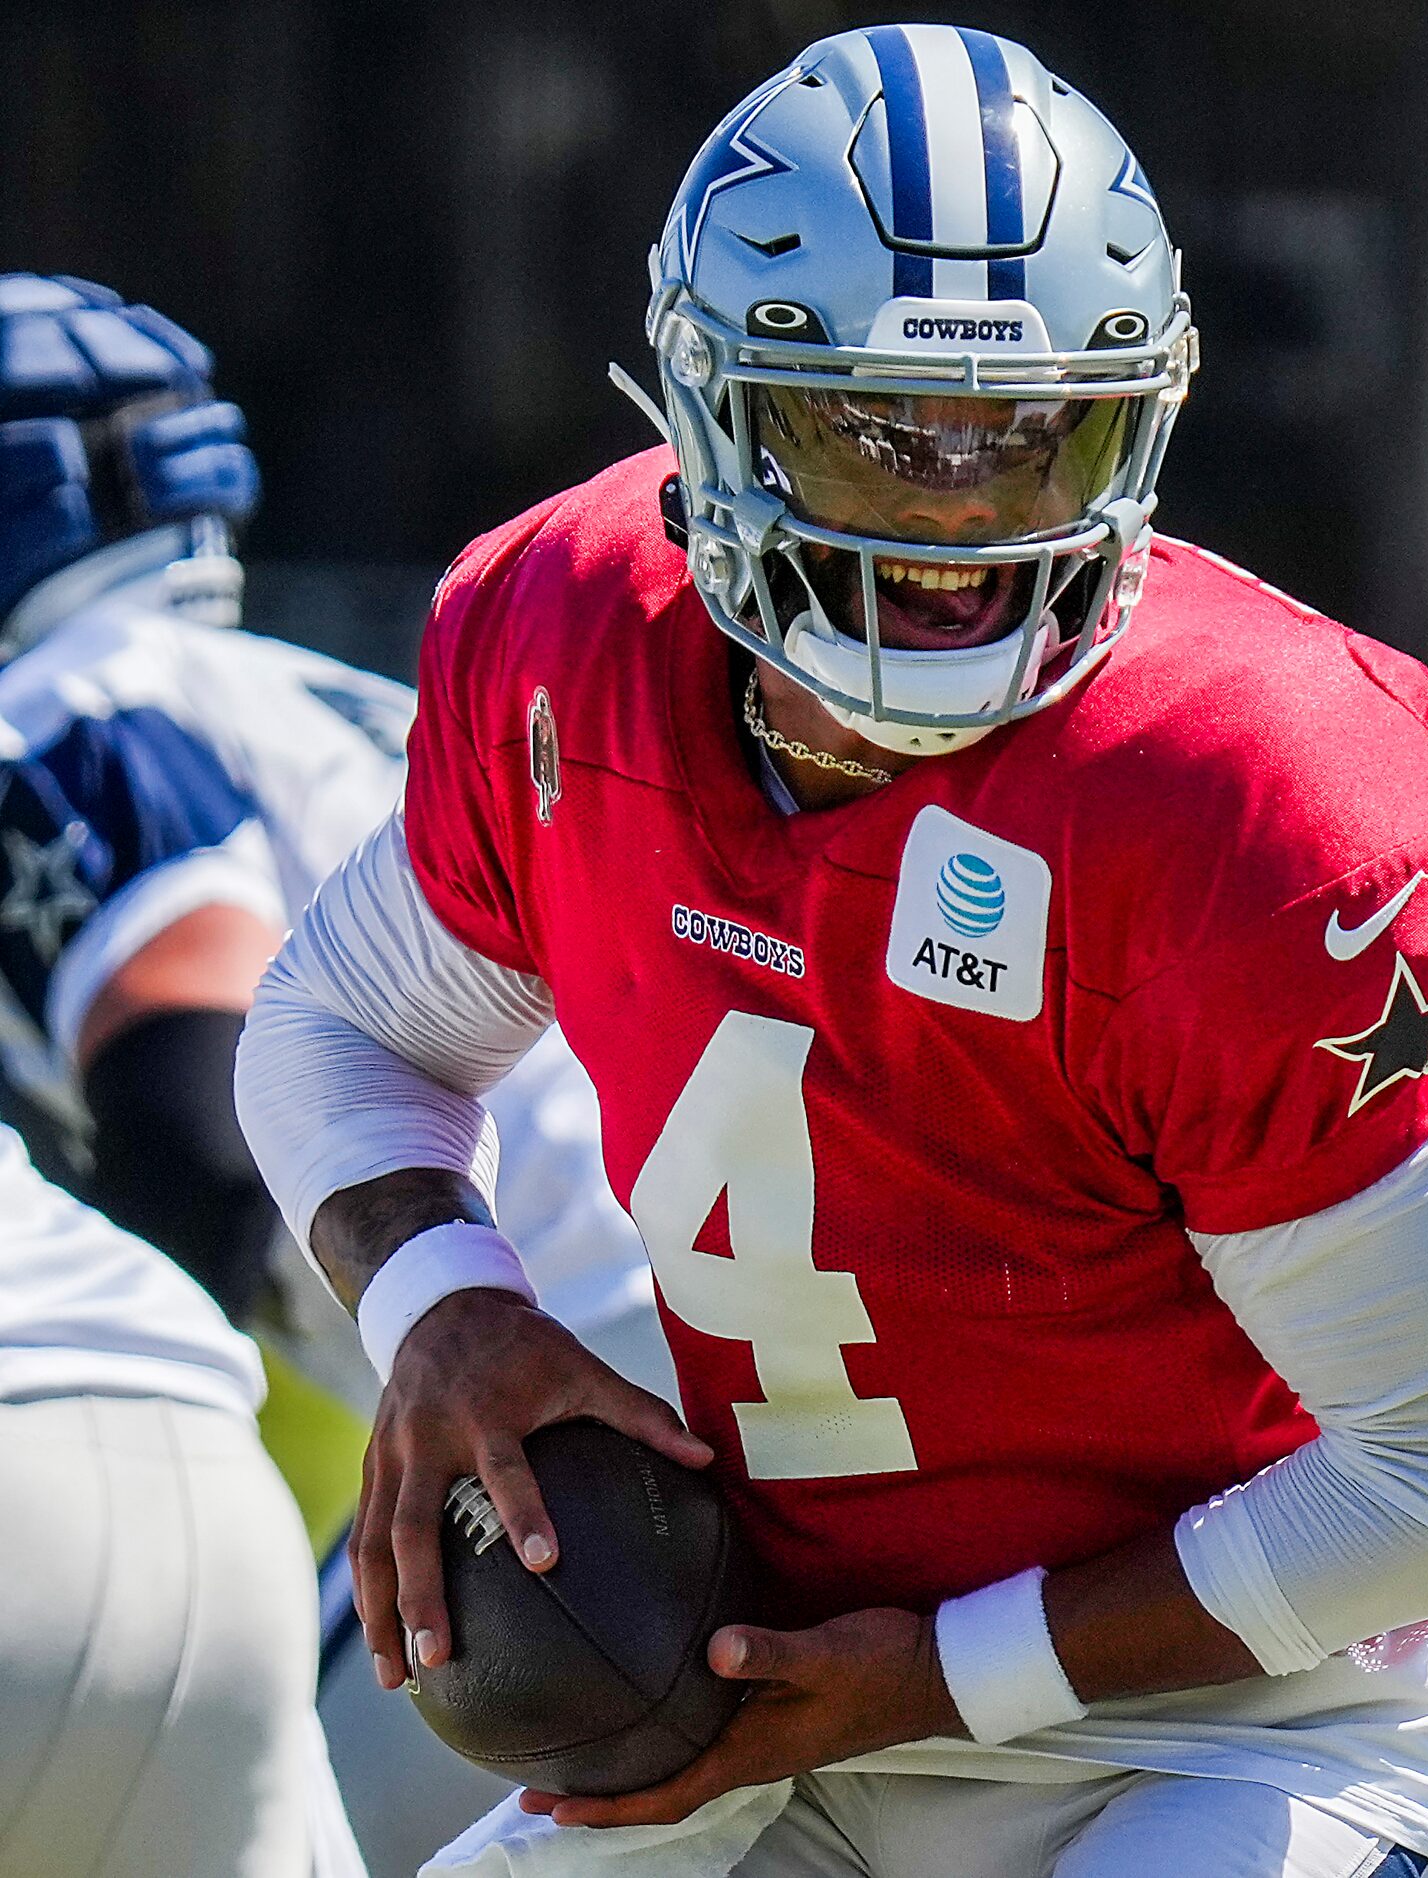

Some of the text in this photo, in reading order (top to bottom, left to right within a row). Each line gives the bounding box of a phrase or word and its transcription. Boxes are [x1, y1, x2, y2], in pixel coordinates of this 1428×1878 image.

[903, 317, 1023, 342] COWBOYS
[673, 904, 806, 977] COWBOYS
[912, 938, 1008, 993] AT&T
[630, 1010, 918, 1480] 4
